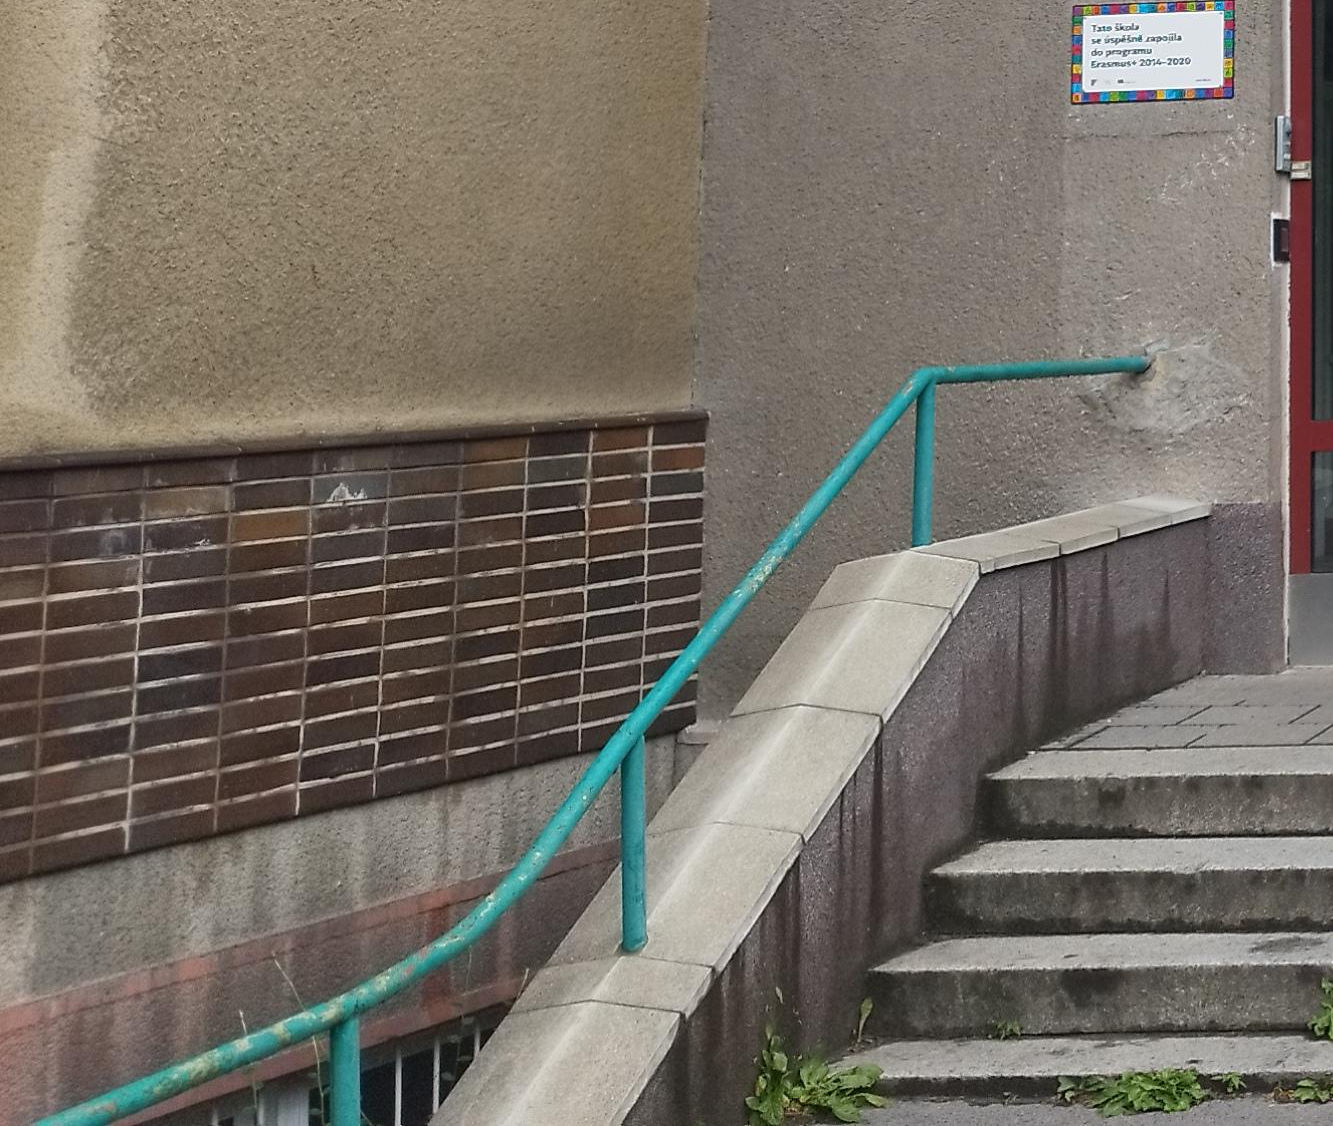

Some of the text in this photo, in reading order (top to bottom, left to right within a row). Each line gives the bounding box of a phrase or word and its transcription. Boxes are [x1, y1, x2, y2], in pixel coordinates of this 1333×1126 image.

[1091, 23, 1140, 33] Tato škola
[1091, 33, 1183, 46] se úspěšně zapojila
[1091, 48, 1153, 58] do programu
[1091, 59, 1137, 69] Erasmus+
